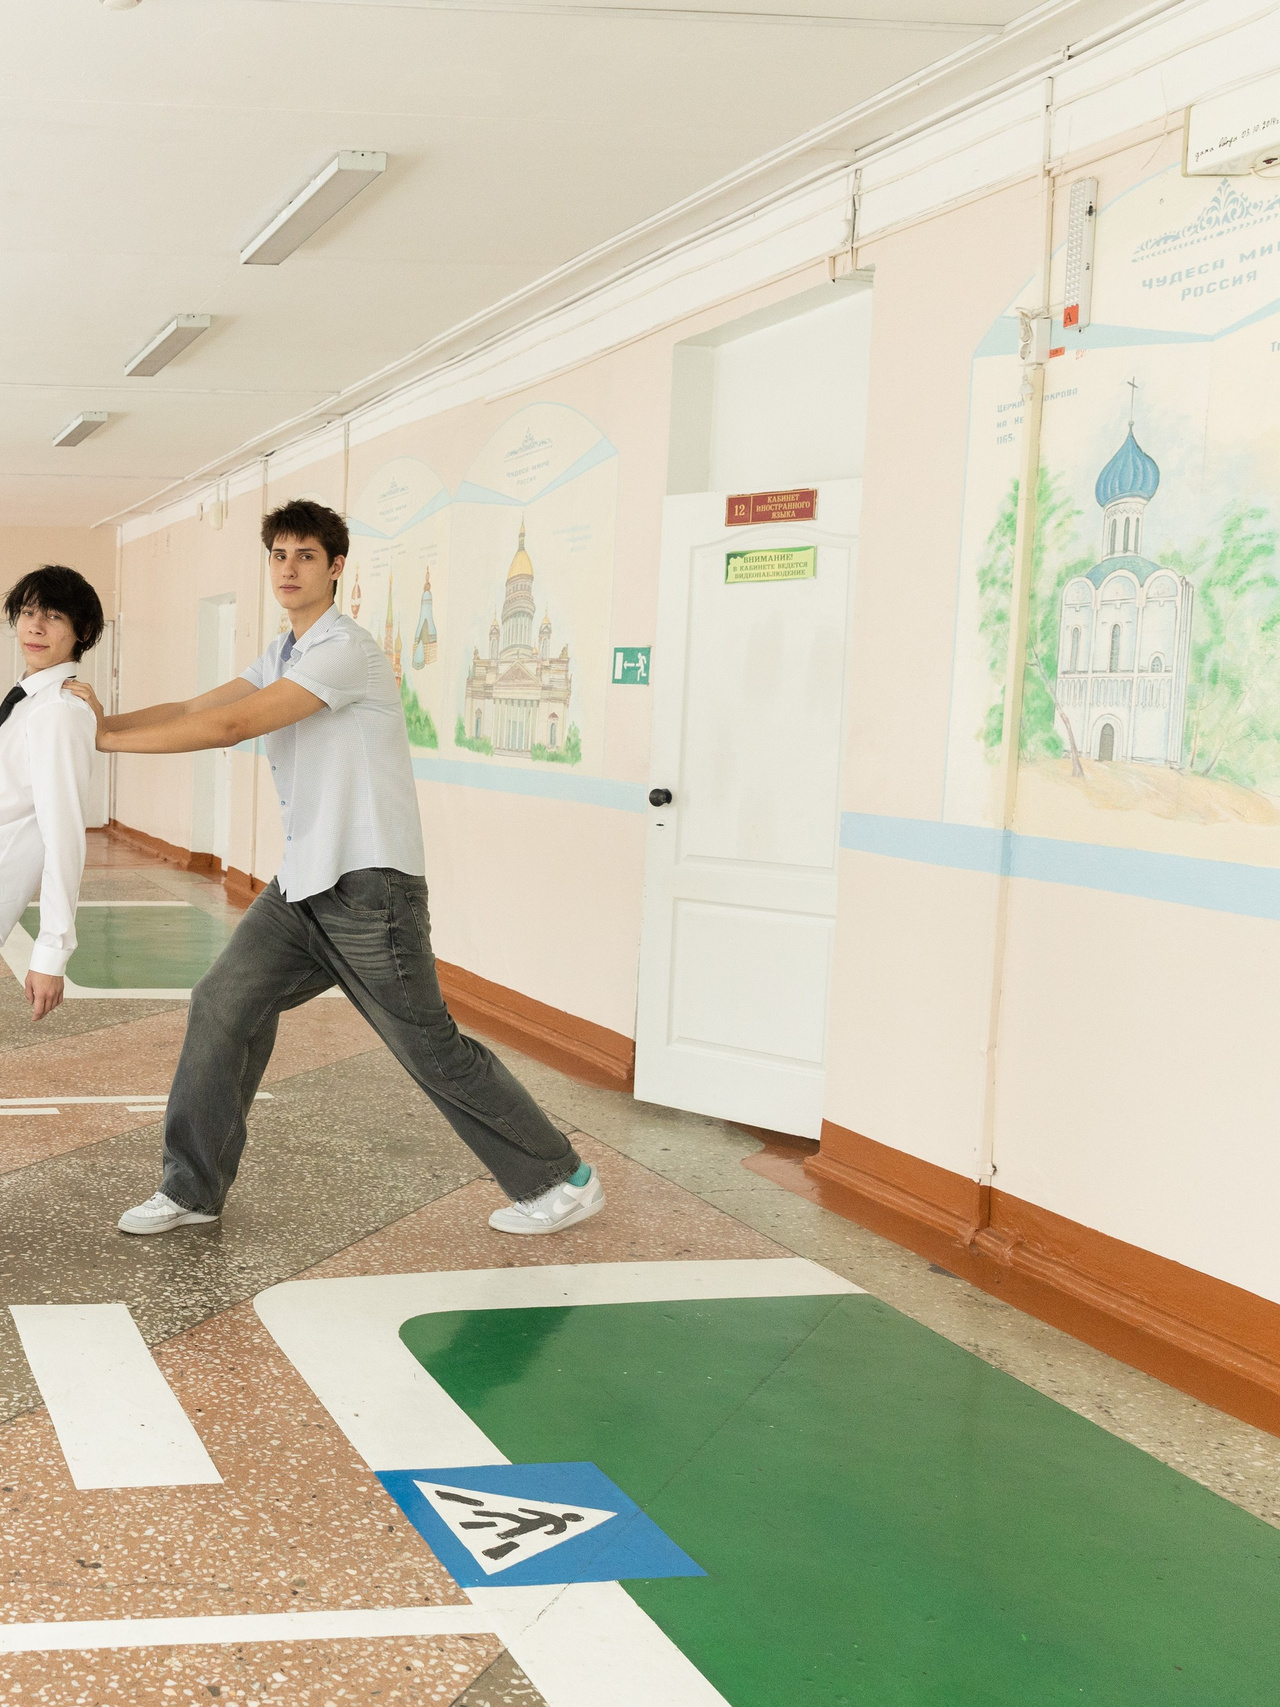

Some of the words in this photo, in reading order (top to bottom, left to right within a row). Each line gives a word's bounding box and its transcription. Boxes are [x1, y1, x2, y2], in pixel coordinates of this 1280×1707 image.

[1141, 258, 1225, 290] ЧУДЕСА
[1181, 269, 1257, 301] РОССИЯ
[996, 399, 1025, 413] ЦЕРКО
[1044, 387, 1078, 402] ОКРОВА
[767, 494, 800, 504] КАБИНЕТ
[734, 504, 746, 516] 12
[756, 502, 811, 512] ИНОСТРАННОГО
[771, 510, 796, 519] ЯЗЫКА
[743, 553, 794, 564] ВНИМАНИЕ!
[739, 563, 776, 572] КАБИНЕТЕ
[777, 562, 808, 570] ВЕДЕТСЯ
[734, 569, 806, 580] ВИДЕОНАБЛЮДЕНИЕ
